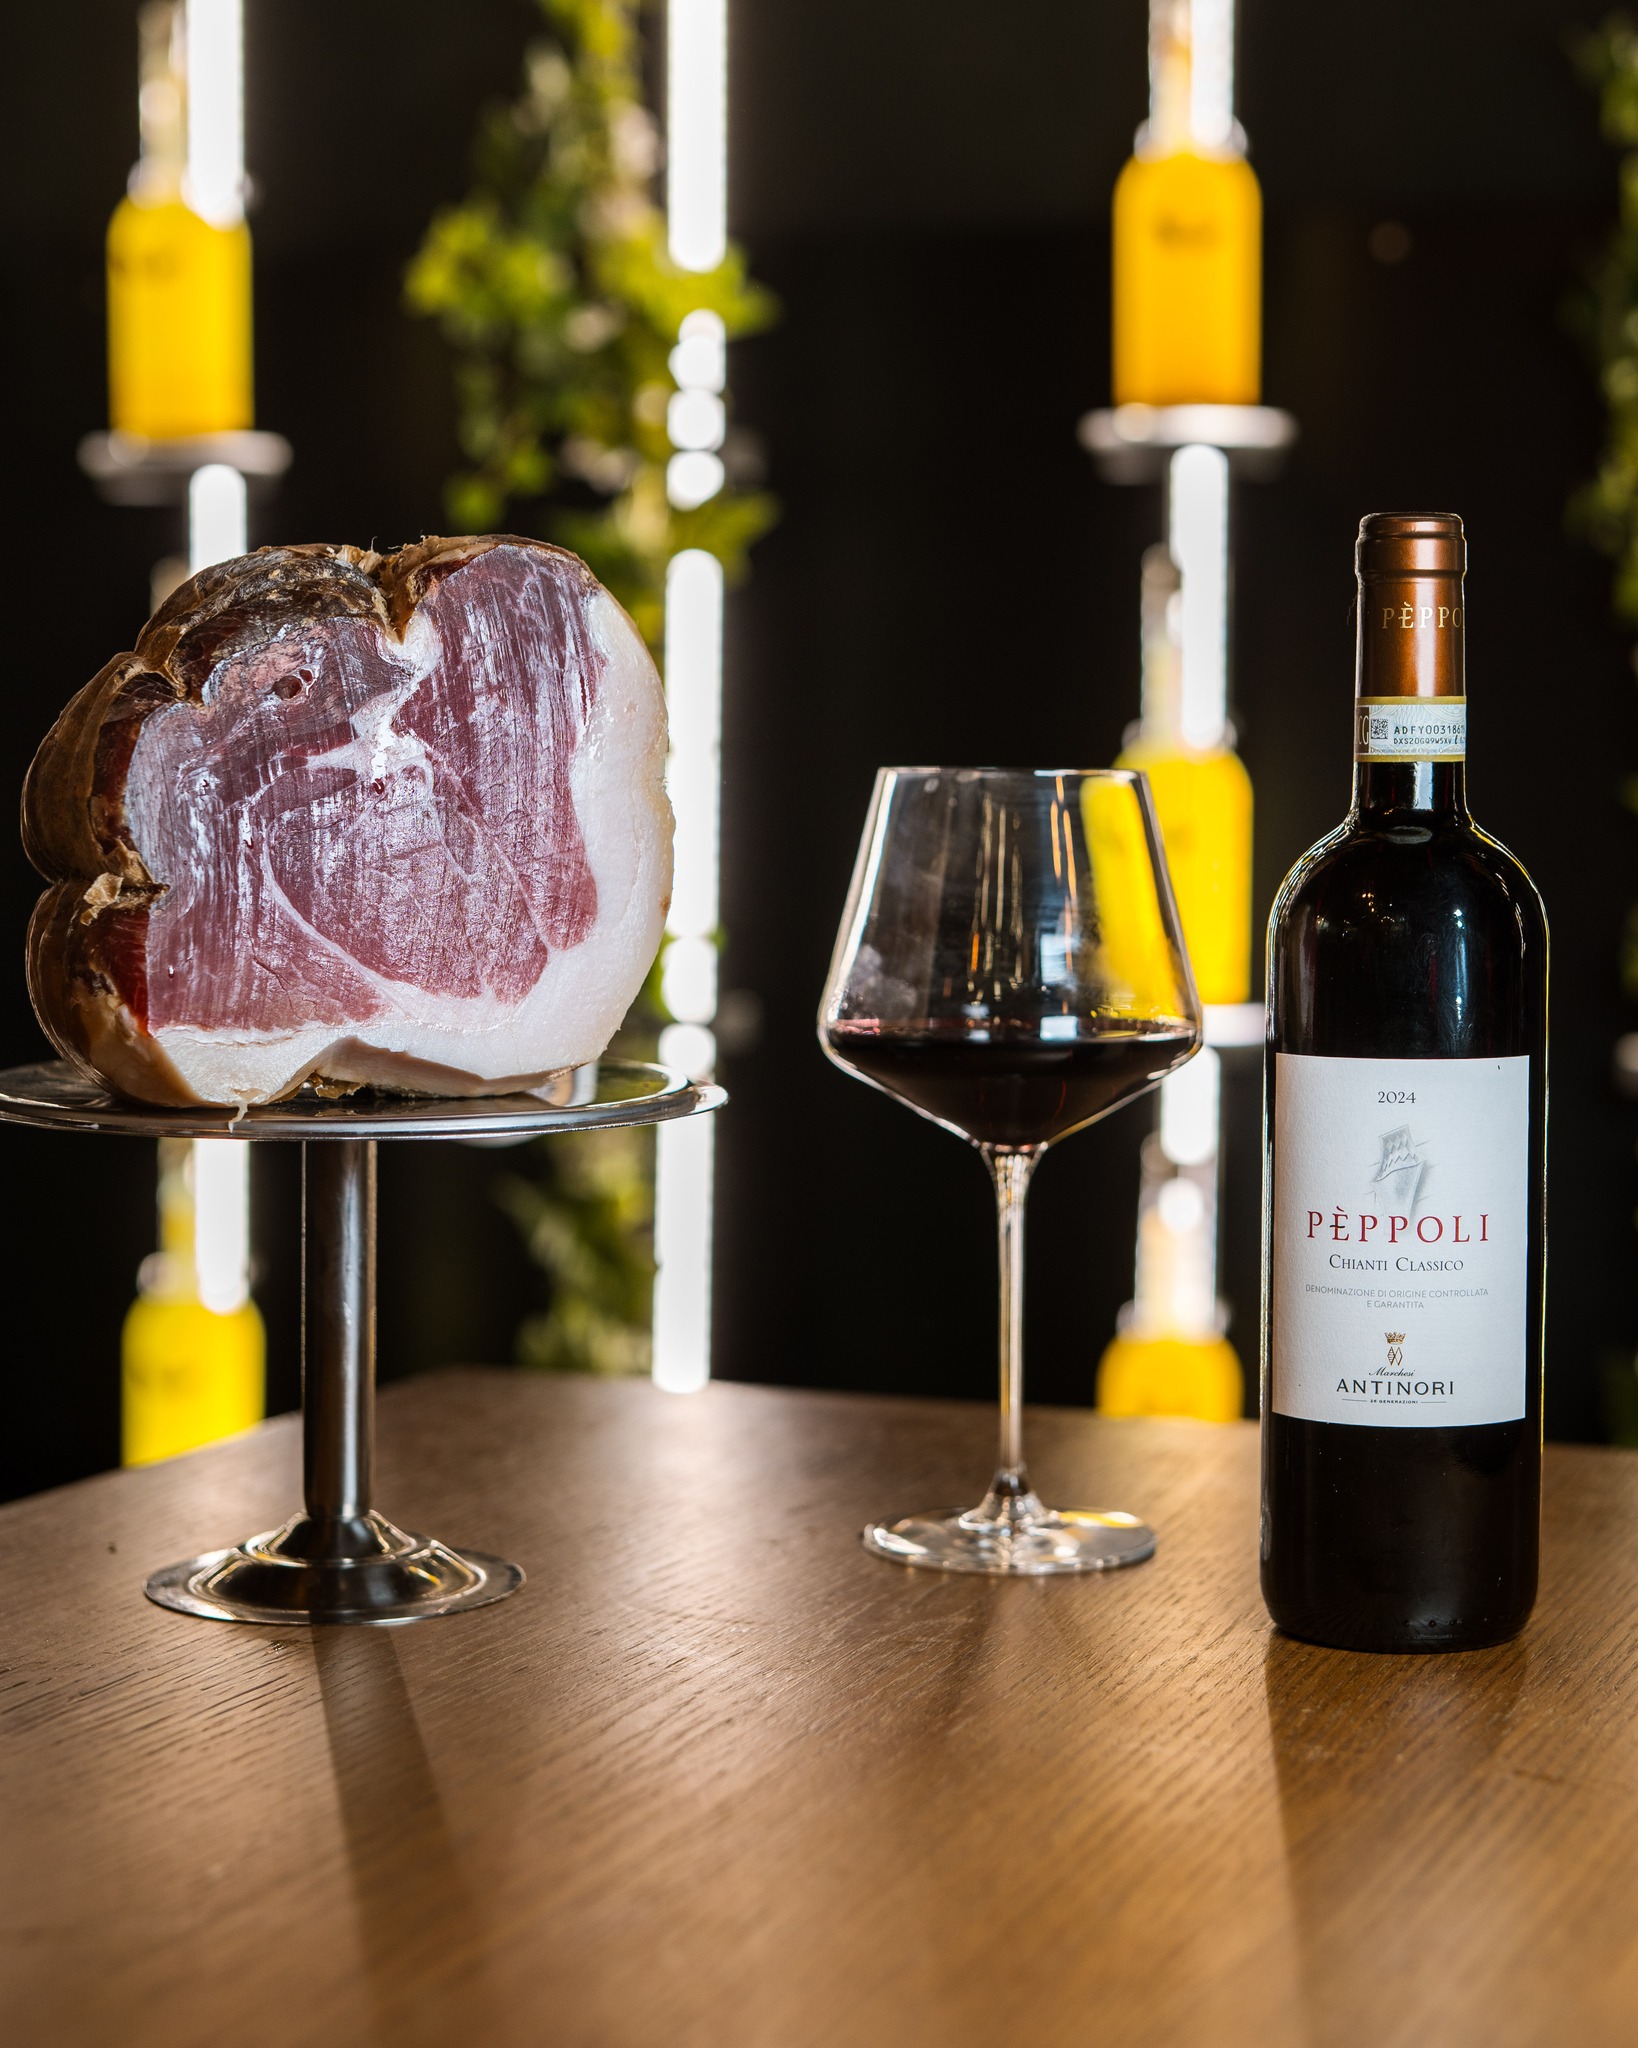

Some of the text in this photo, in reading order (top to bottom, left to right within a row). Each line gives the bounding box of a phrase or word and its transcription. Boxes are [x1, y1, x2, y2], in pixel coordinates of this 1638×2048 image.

[1377, 1091, 1416, 1104] 2024
[1307, 1206, 1489, 1244] PÈPPOLI
[1305, 1284, 1489, 1299] DENOMINAZIONE DI ORIGINE CONTROLLATA
[1366, 1300, 1424, 1309] E GARANTITA
[1368, 1366, 1416, 1377] Marchesi
[1336, 1378, 1454, 1396] ANTINORI
